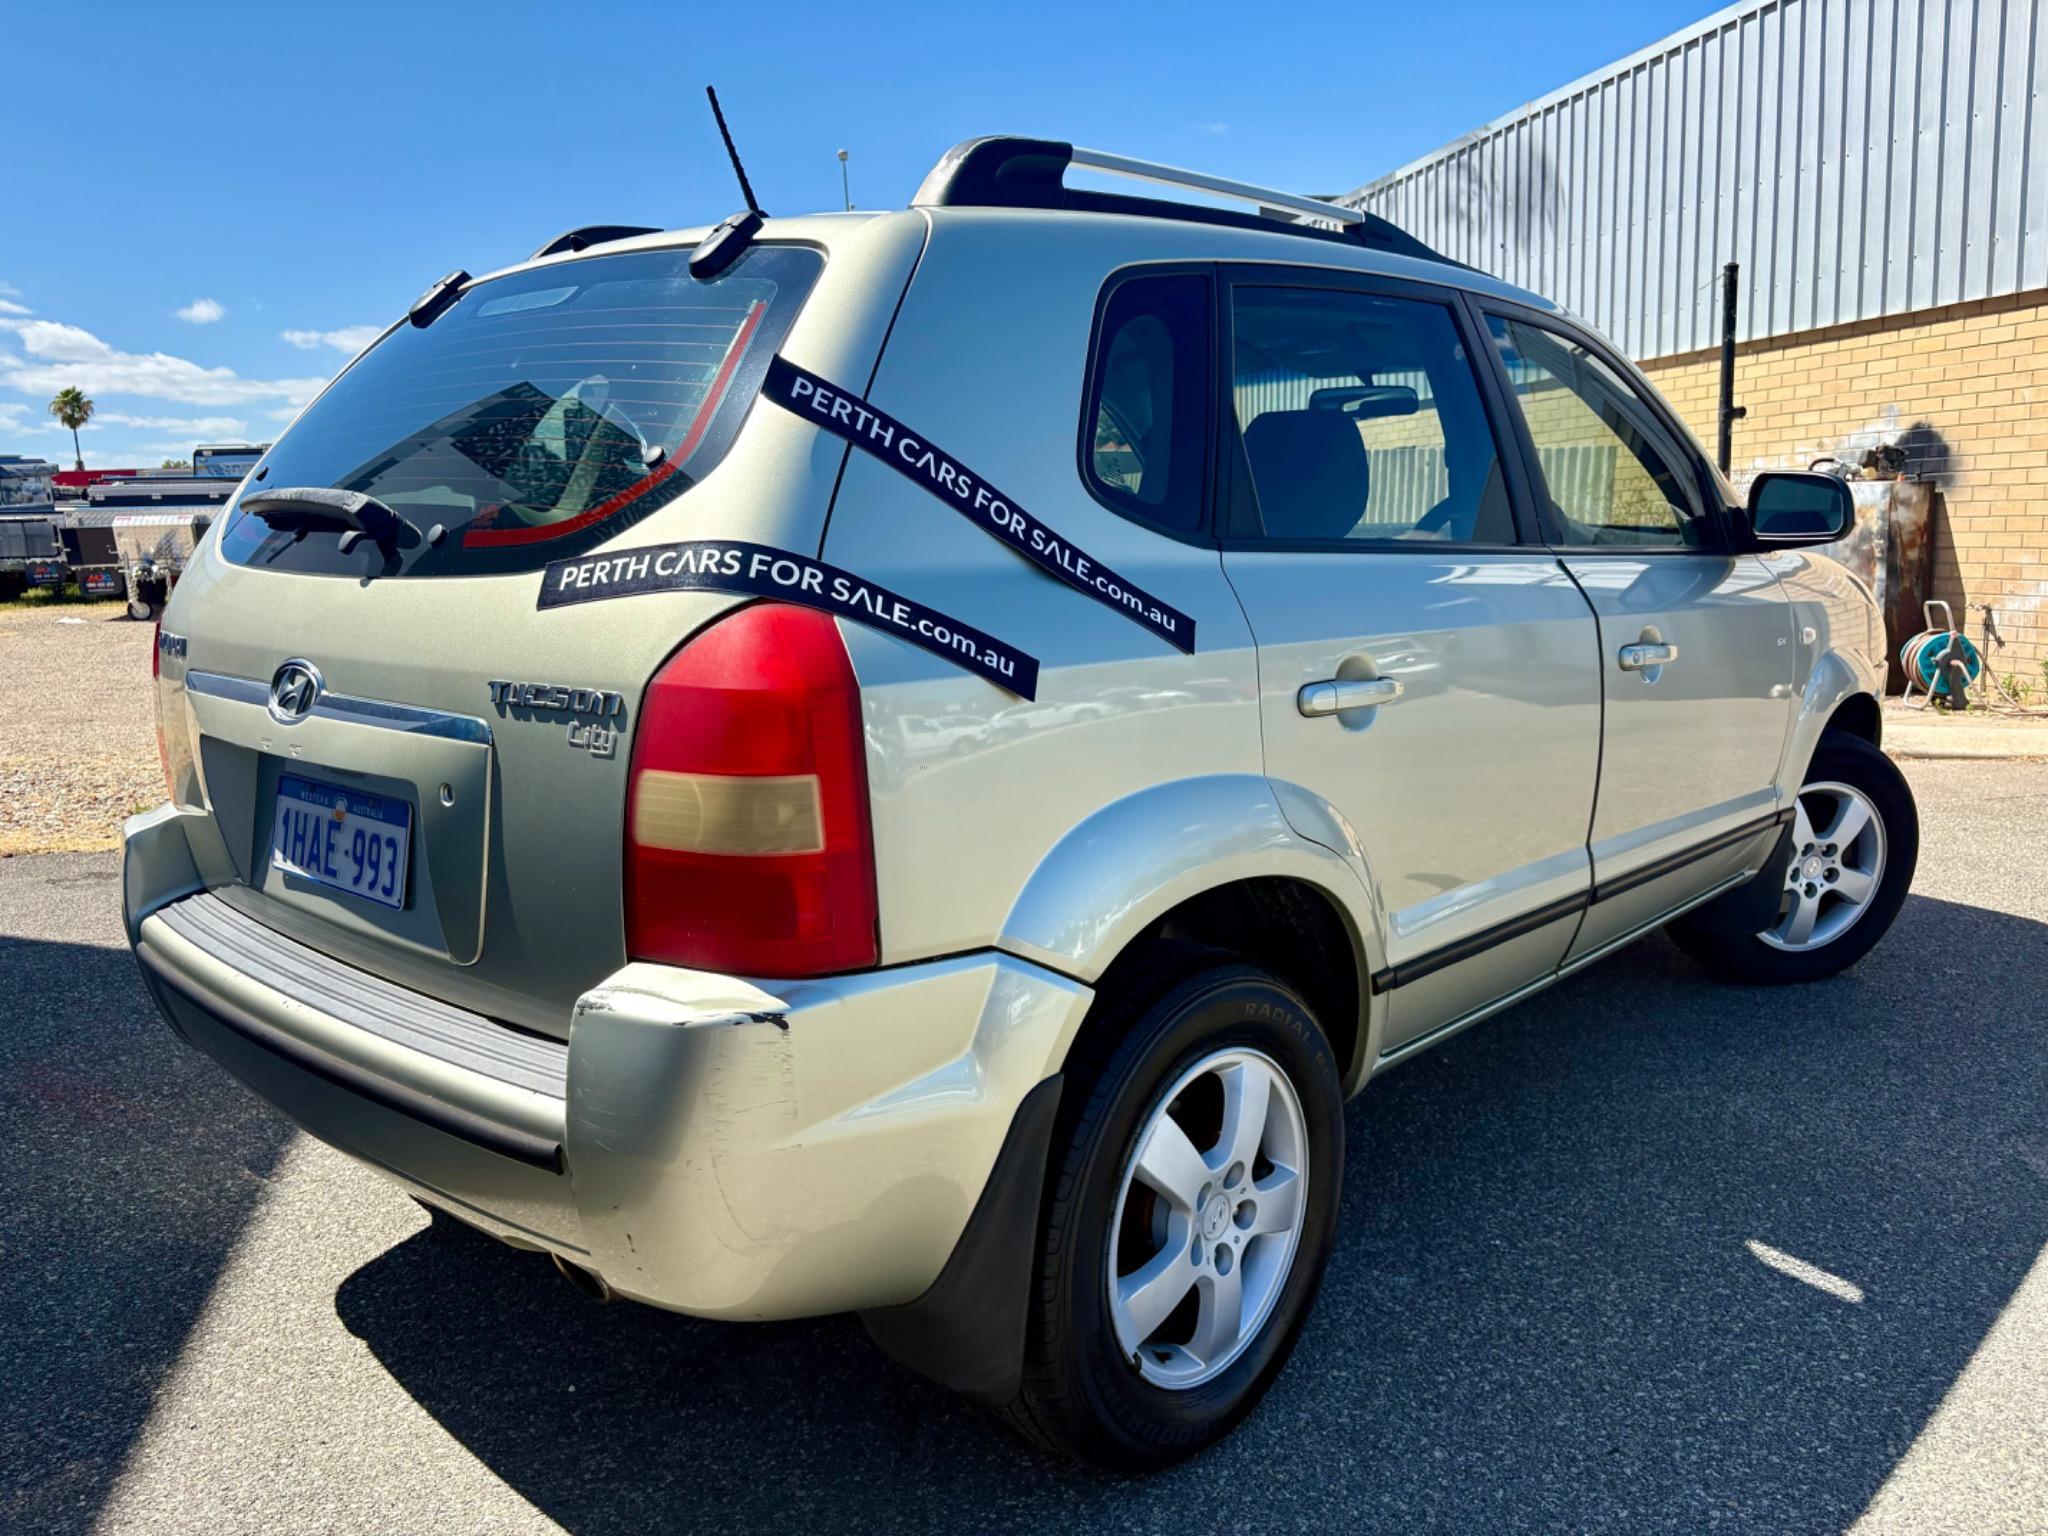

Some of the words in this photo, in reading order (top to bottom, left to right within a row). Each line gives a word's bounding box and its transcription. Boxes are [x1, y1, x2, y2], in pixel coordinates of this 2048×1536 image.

[790, 376, 895, 448] PERTH
[898, 438, 972, 498] CARS
[974, 487, 1026, 540] FOR
[1030, 529, 1176, 632] SALE.com.au
[559, 554, 650, 591] PERTH
[654, 549, 742, 576] CARS
[749, 553, 824, 594] FOR
[831, 577, 1014, 677] SALE.com.au
[488, 679, 622, 716] TUCSON
[566, 720, 617, 755] City
[1244, 1003, 1312, 1041] RADIAL
